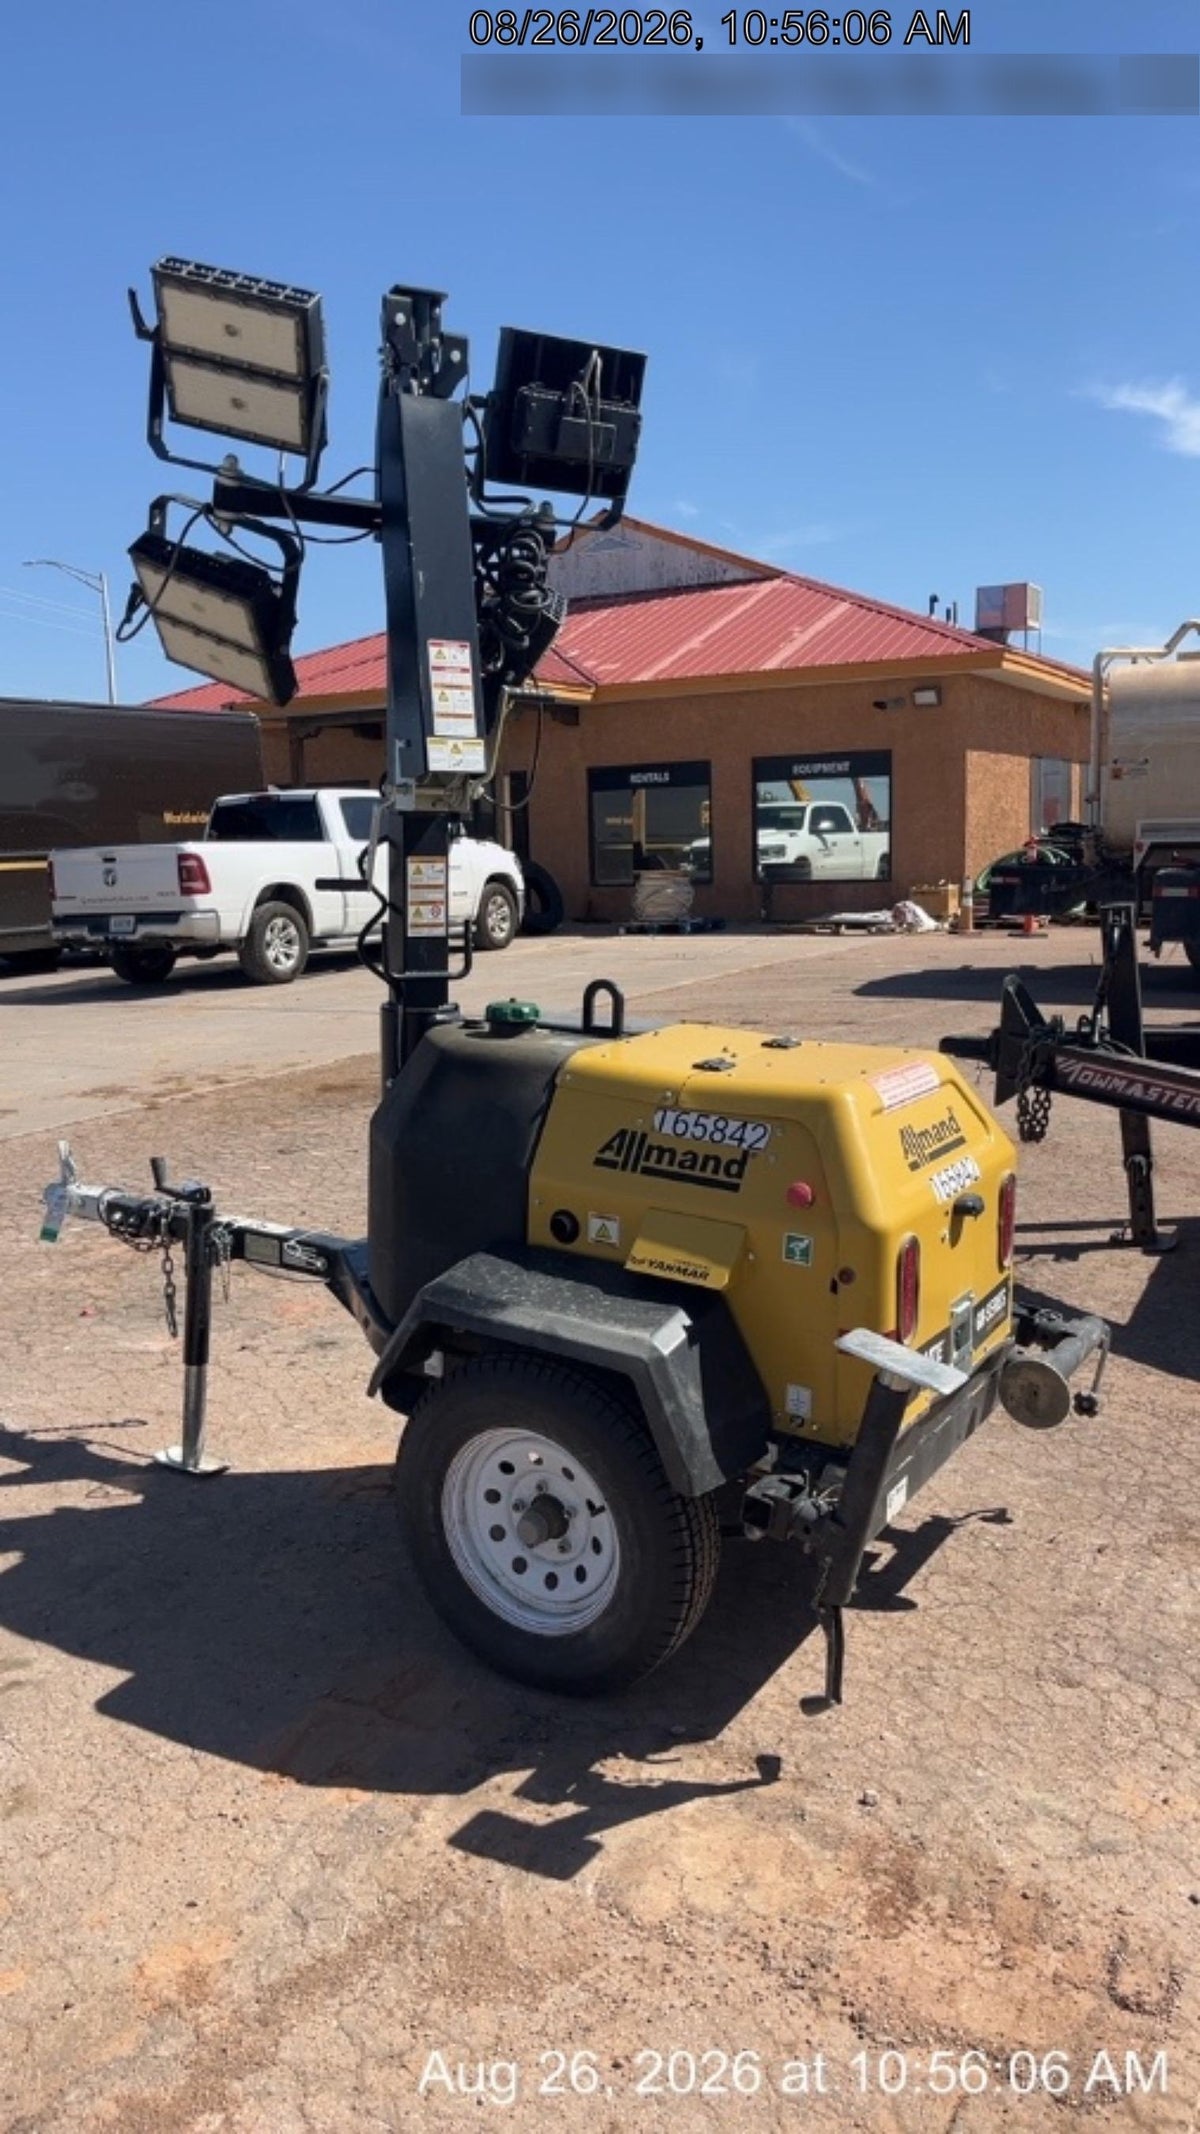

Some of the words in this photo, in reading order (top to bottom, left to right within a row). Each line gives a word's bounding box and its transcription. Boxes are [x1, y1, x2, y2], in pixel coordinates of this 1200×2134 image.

[629, 772, 670, 784] RENTALS
[792, 761, 850, 775] EQUIPMENT
[658, 1109, 768, 1151] 165842
[898, 1106, 961, 1166] Allmand
[596, 1128, 749, 1180] Allmand
